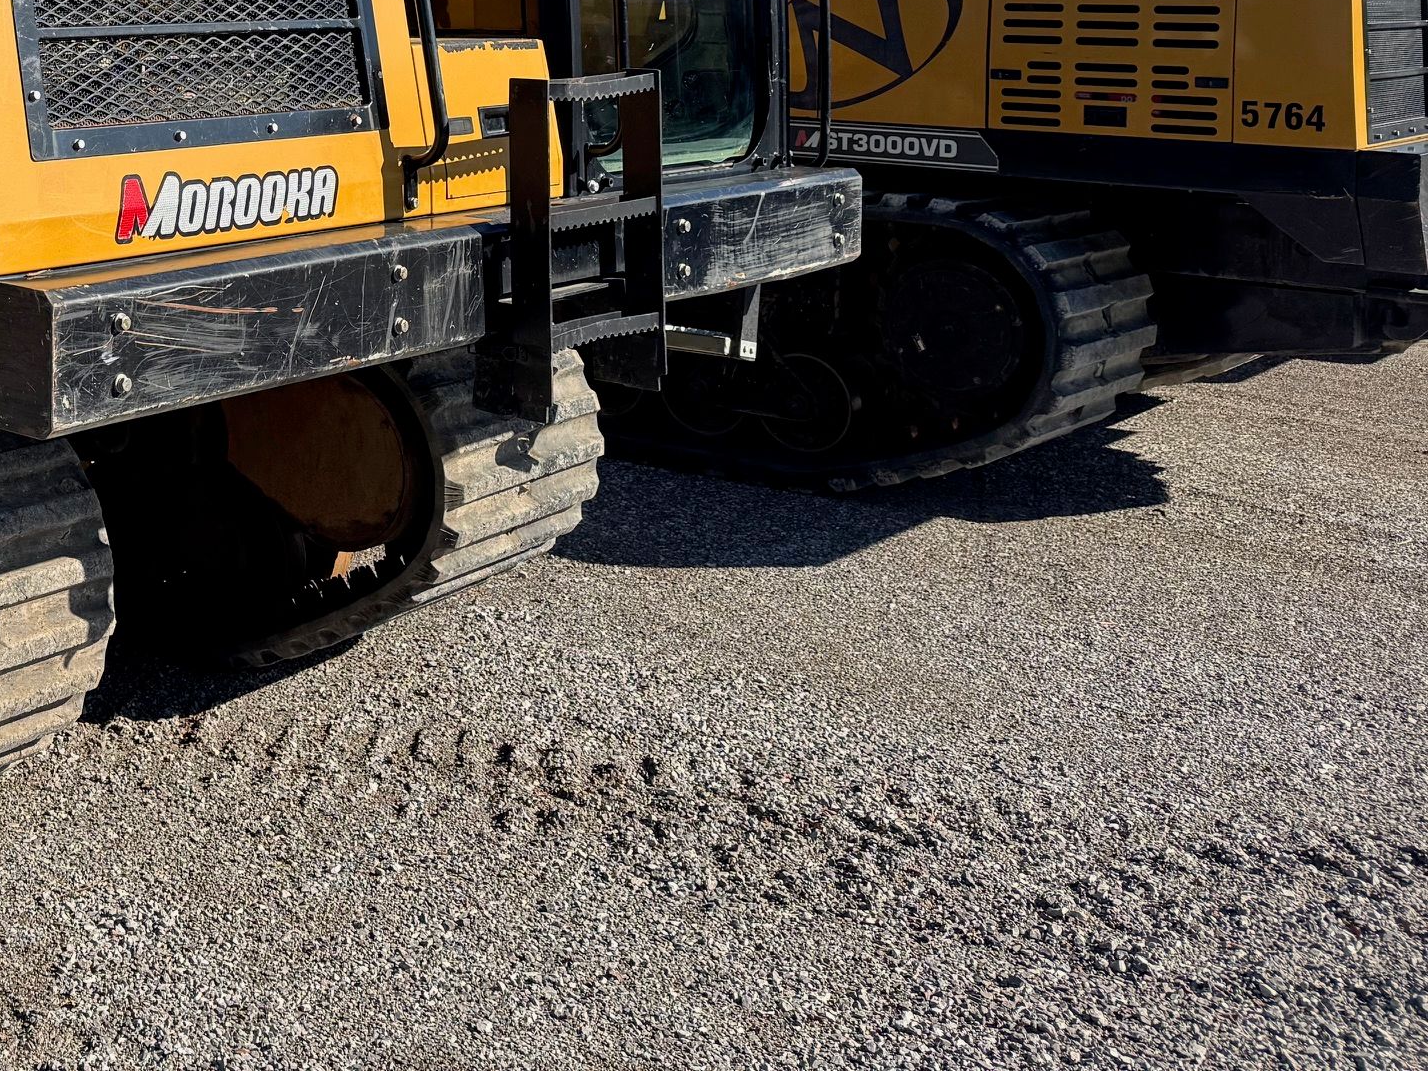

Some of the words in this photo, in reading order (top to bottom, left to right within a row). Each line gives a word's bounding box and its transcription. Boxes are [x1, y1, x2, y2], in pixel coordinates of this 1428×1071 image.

[1241, 100, 1326, 133] 5764
[794, 129, 958, 159] MST3000VD
[115, 166, 339, 244] MOROOKA
